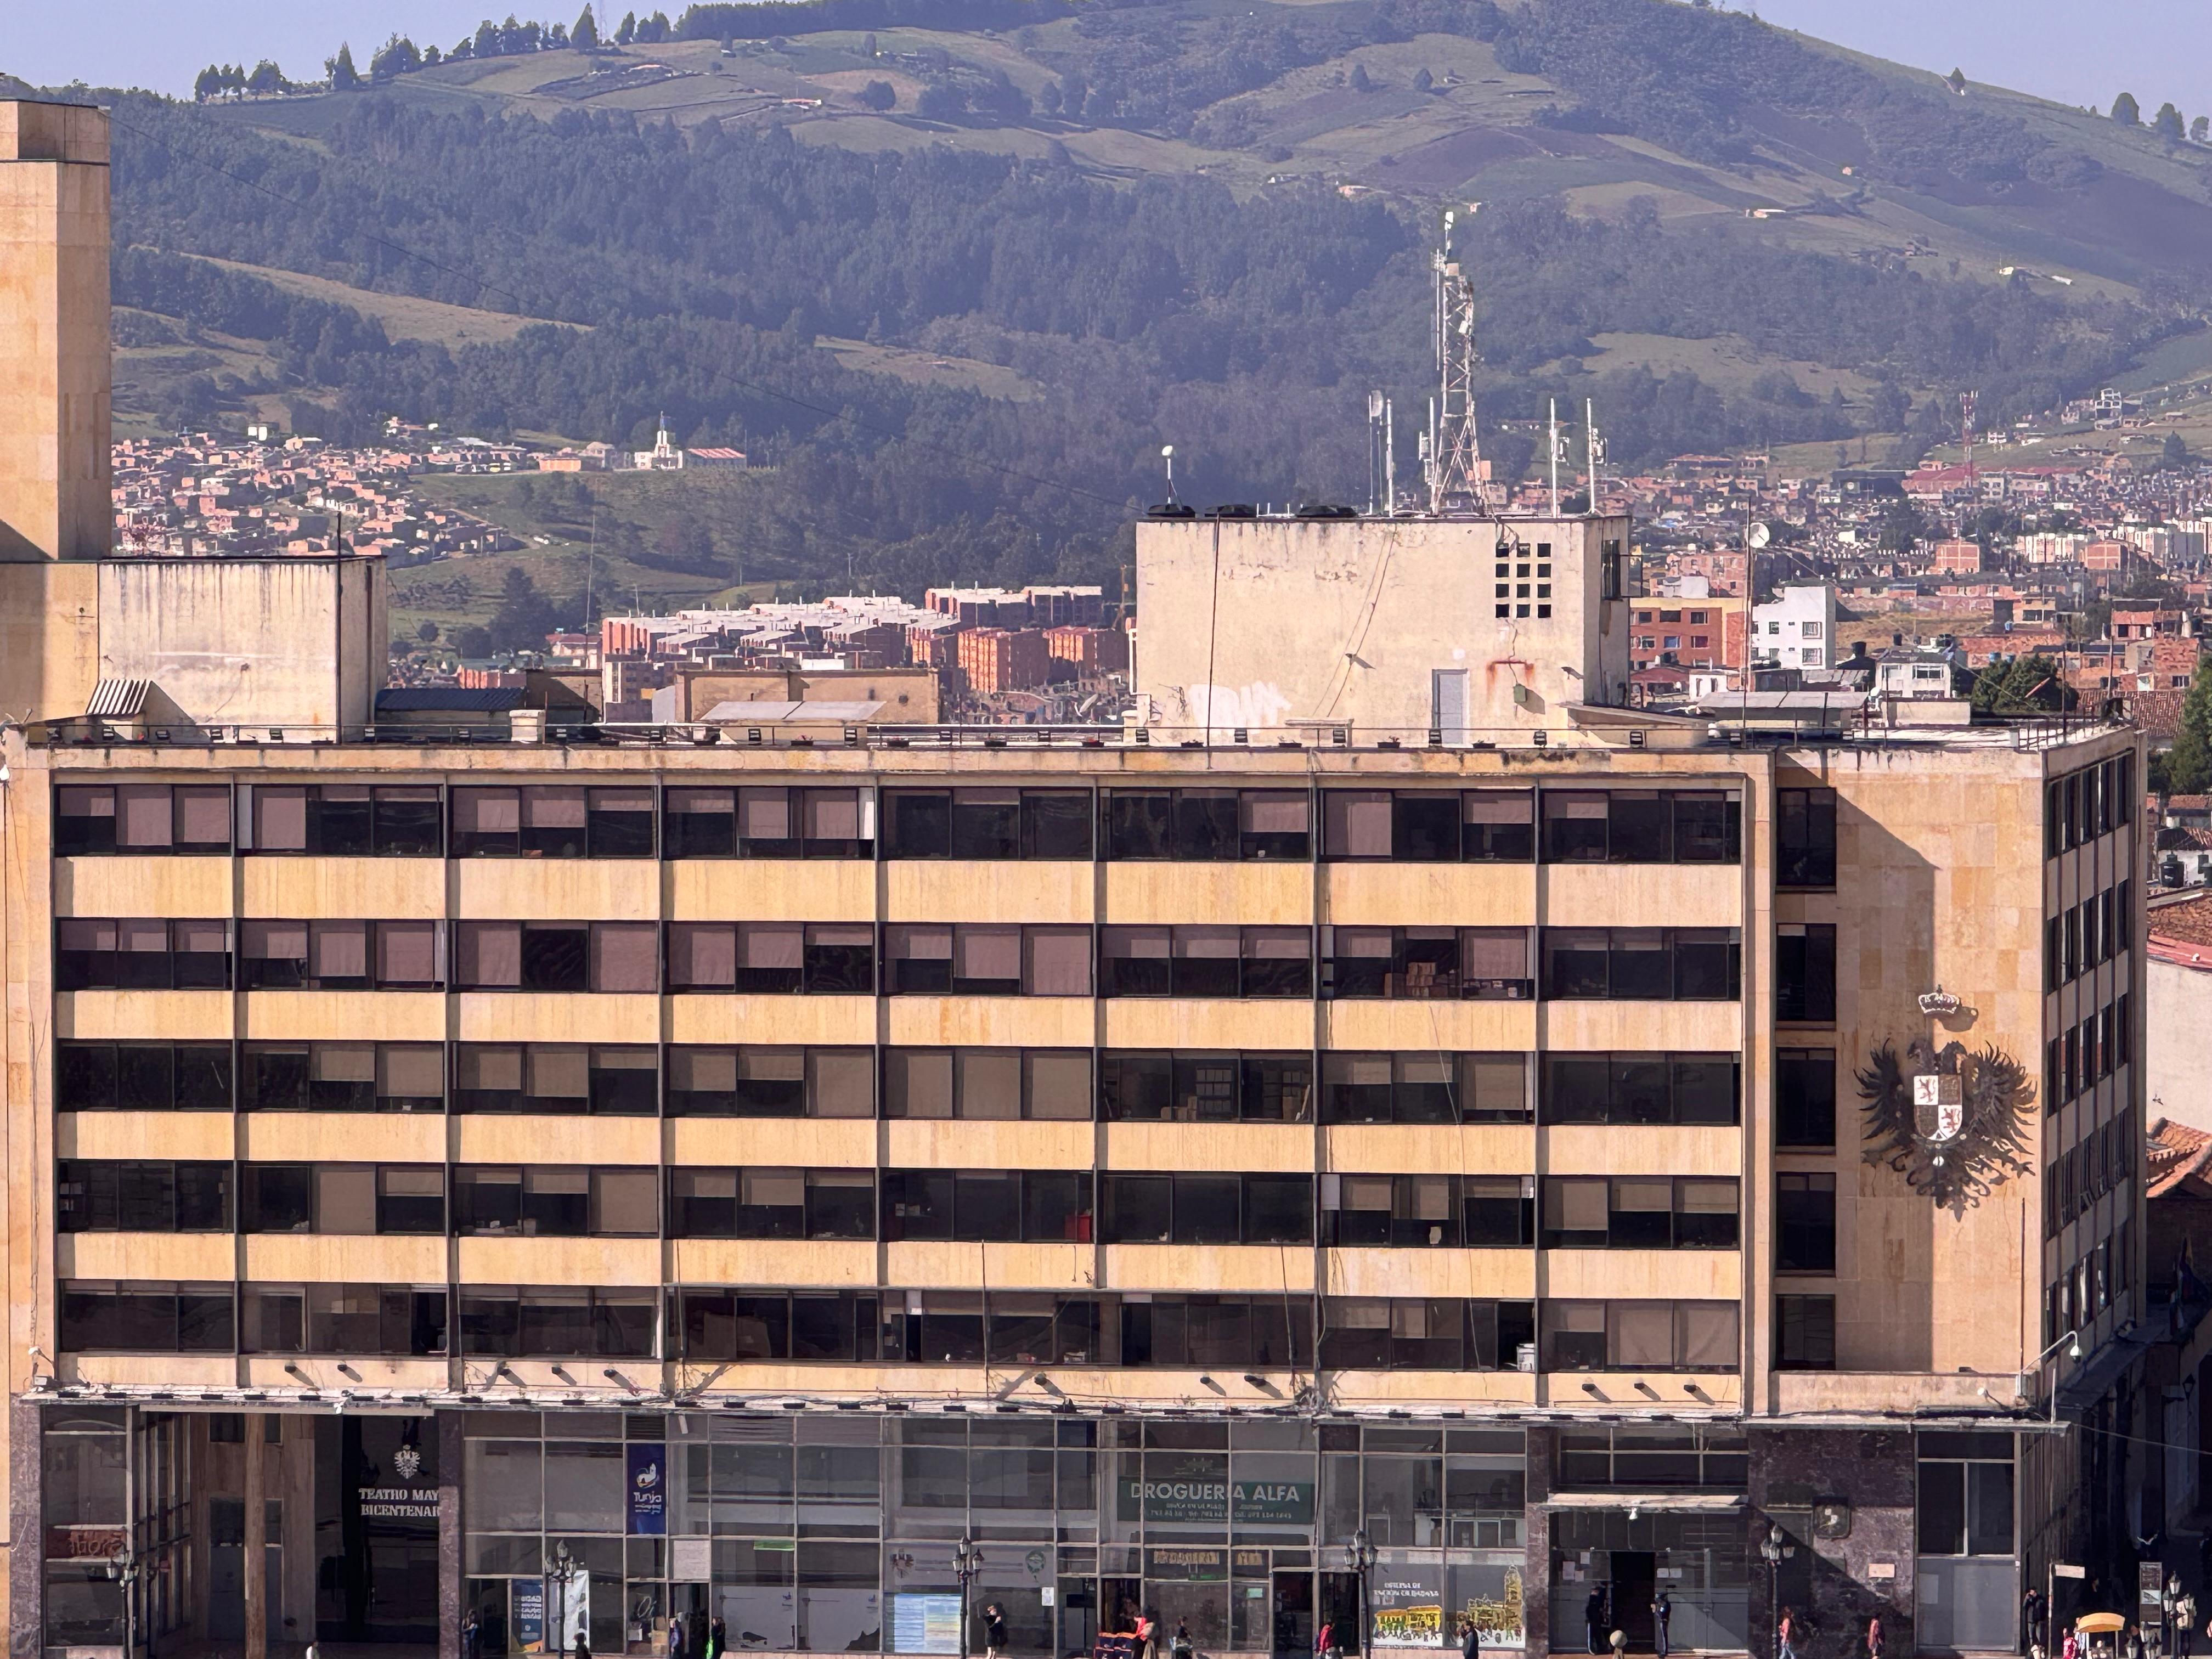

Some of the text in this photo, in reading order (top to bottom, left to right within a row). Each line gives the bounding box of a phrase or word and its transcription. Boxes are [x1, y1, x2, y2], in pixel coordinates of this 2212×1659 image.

[358, 1488, 408, 1500] TEATRO
[633, 1491, 662, 1503] Tunja
[1131, 1482, 1300, 1502] DROGUERA ALFA
